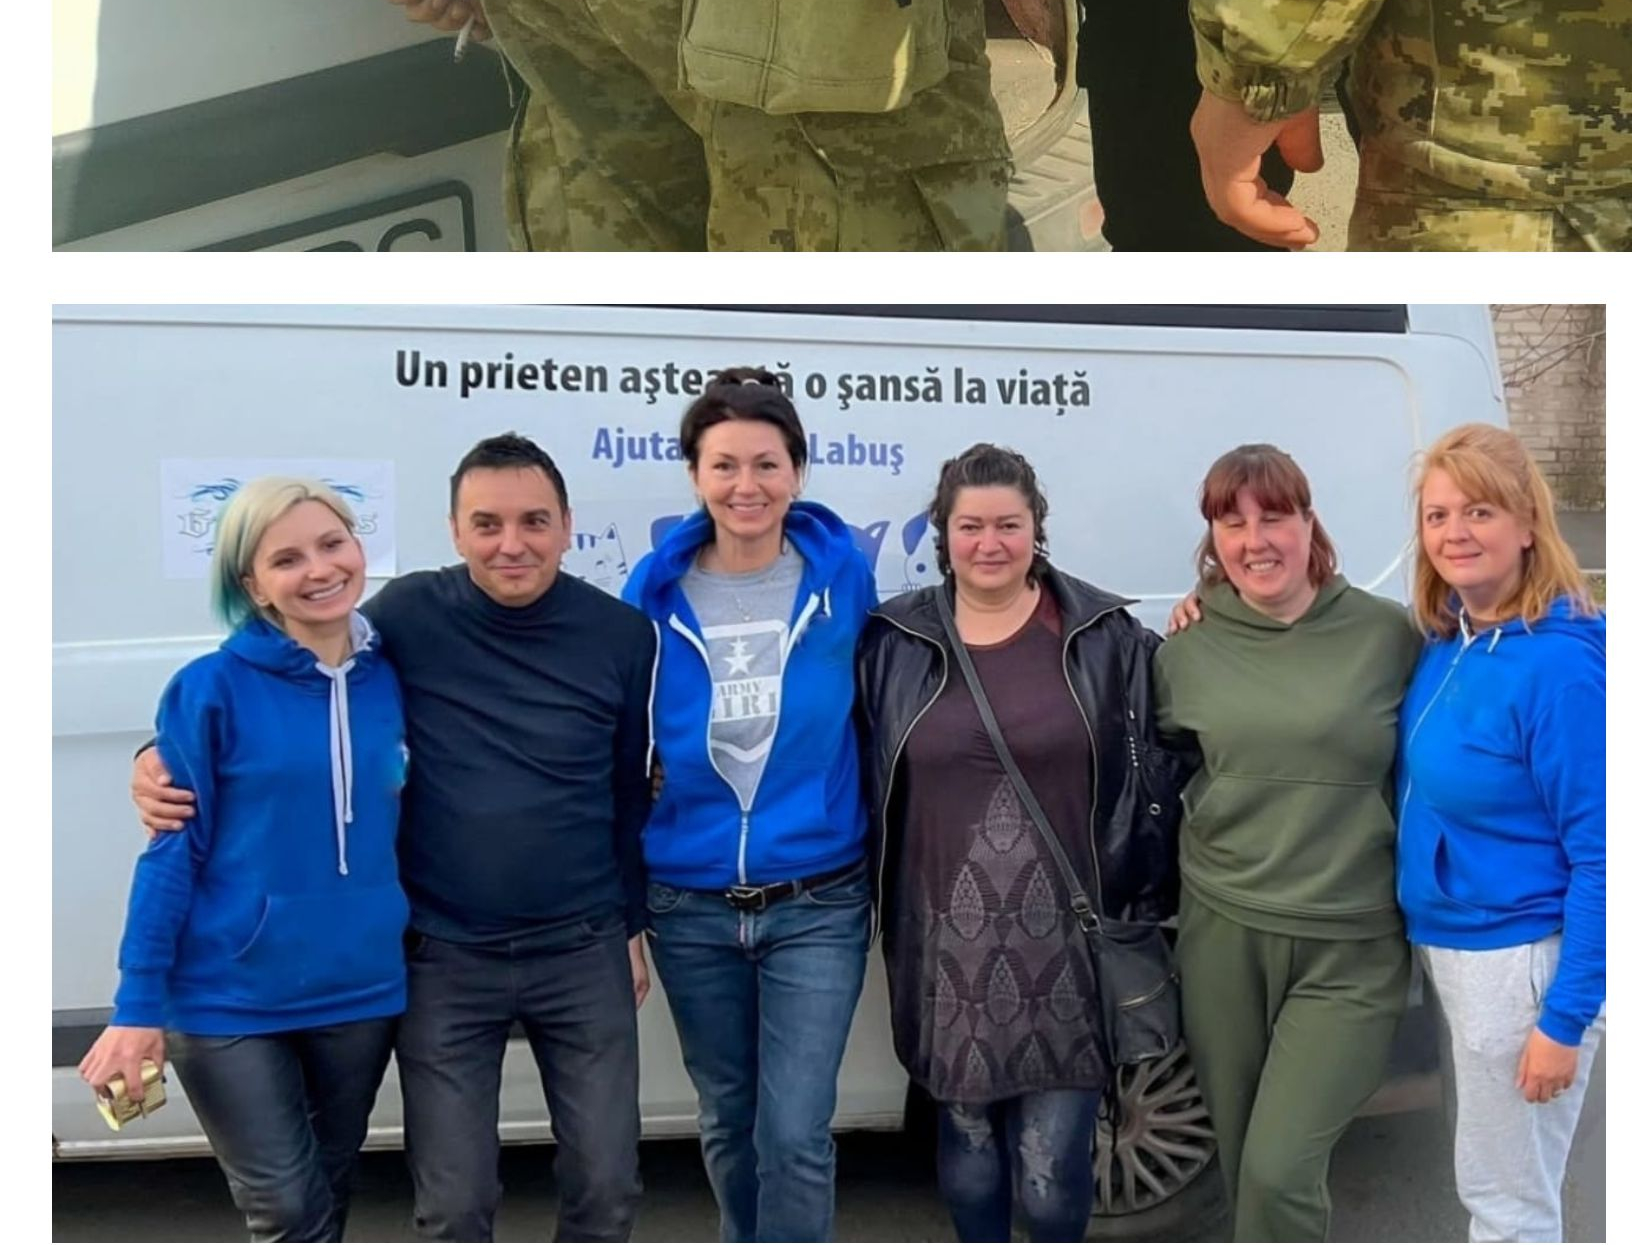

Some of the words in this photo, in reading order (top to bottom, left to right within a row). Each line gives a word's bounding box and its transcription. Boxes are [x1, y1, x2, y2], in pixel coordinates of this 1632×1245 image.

[396, 350, 448, 387] Un
[461, 352, 608, 398] prieten
[619, 362, 794, 404] aşteă
[805, 372, 827, 399] o
[954, 368, 986, 404] la
[592, 427, 684, 468] Ajuta
[717, 681, 765, 698] ARMY
